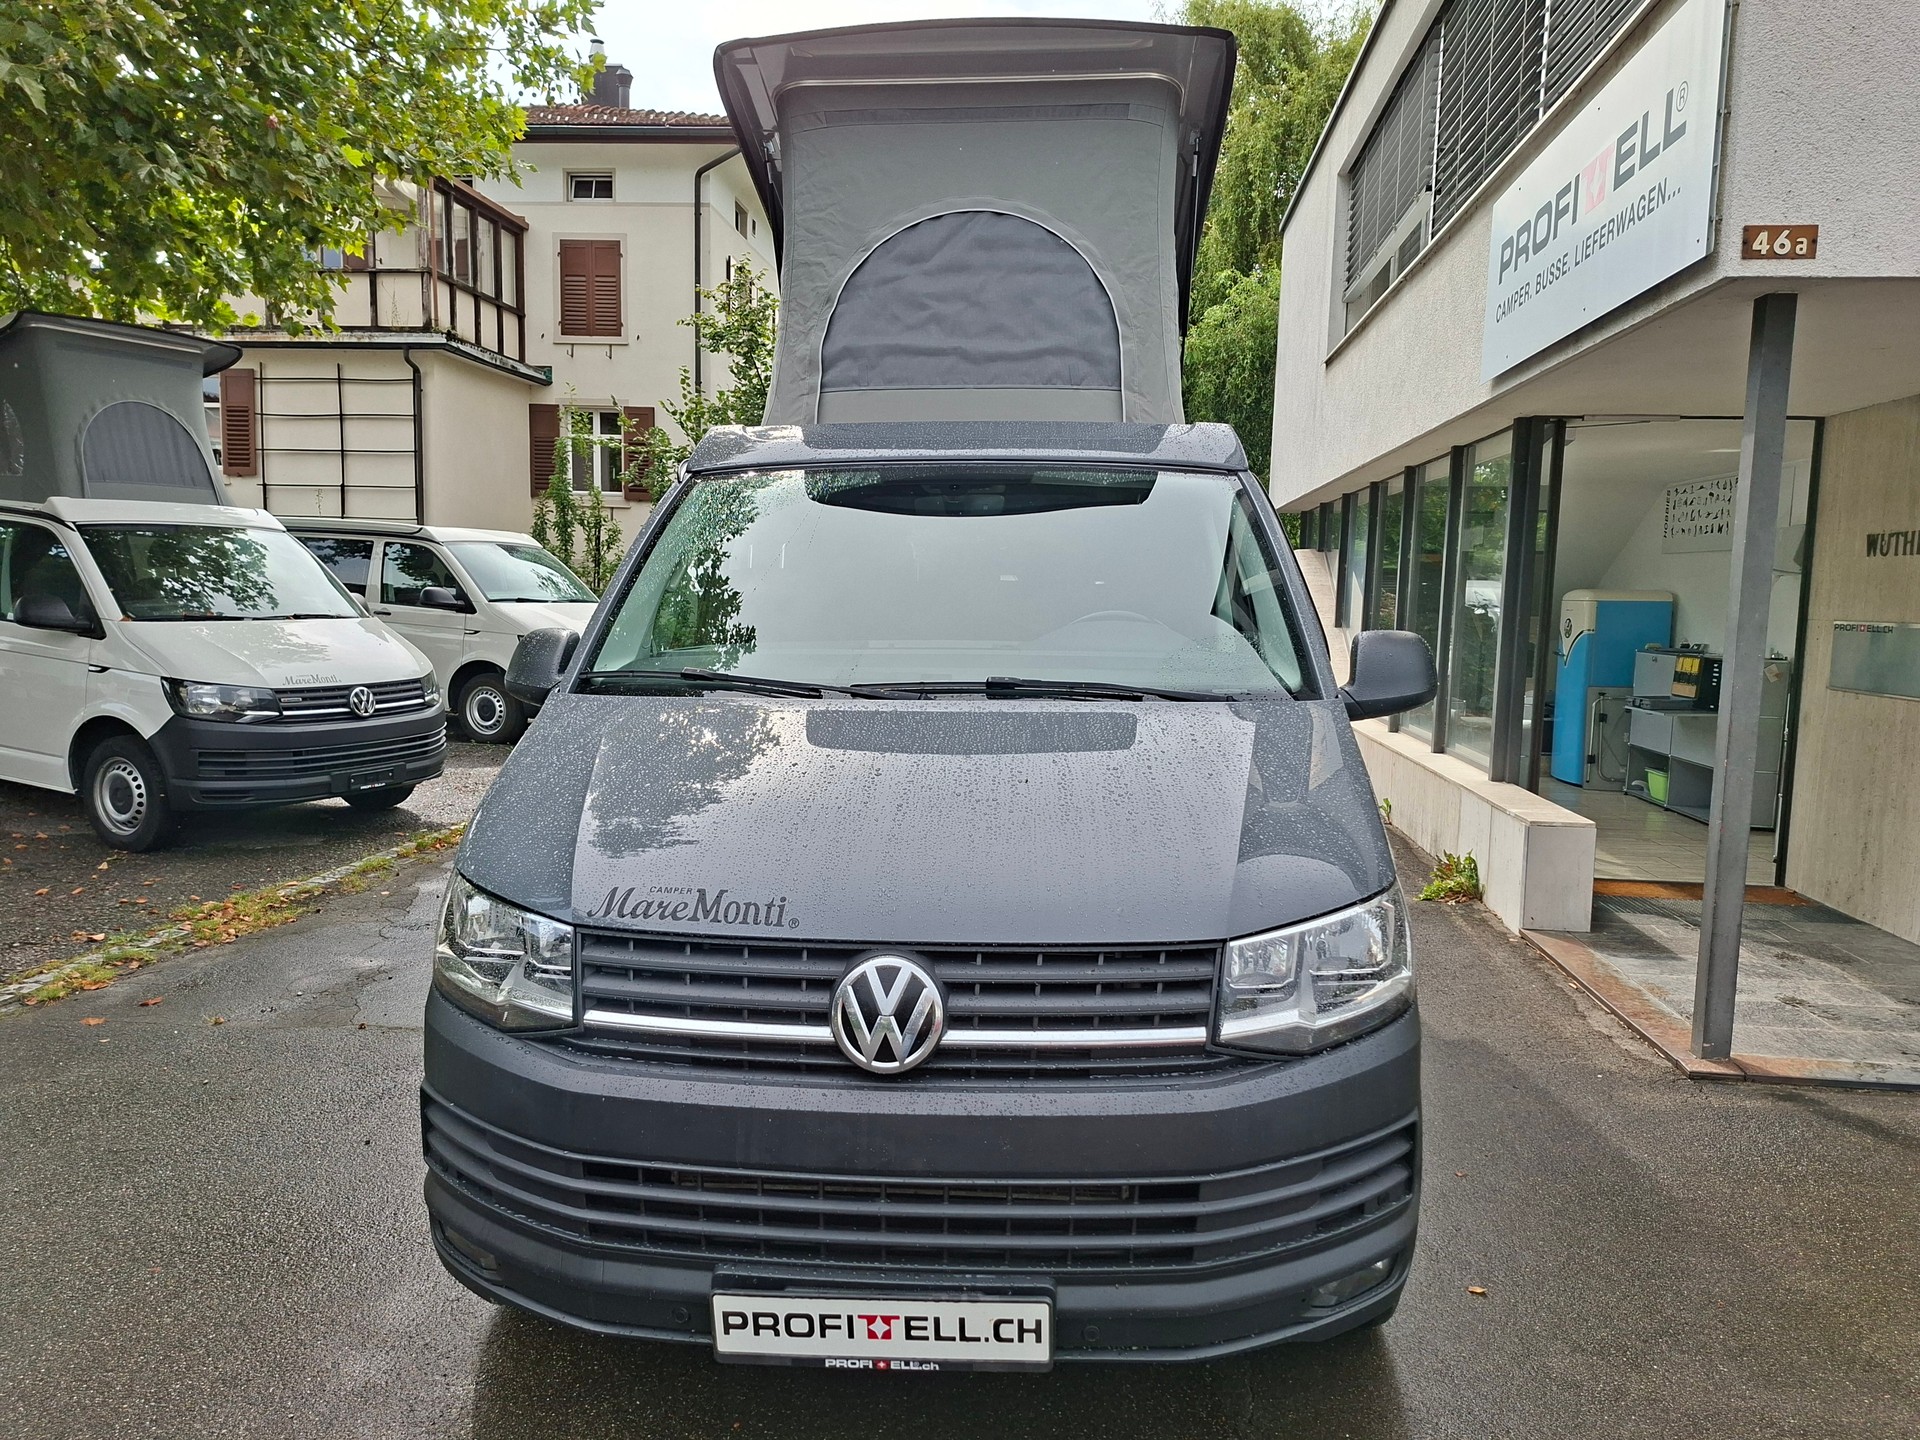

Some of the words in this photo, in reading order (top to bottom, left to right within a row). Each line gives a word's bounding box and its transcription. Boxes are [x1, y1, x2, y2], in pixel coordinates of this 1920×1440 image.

[1751, 229, 1808, 256] 46a
[1495, 281, 1532, 324] CAMPER.
[1535, 261, 1570, 296] BUSSE.
[649, 885, 693, 895] CAMPER
[831, 954, 944, 1075] VW
